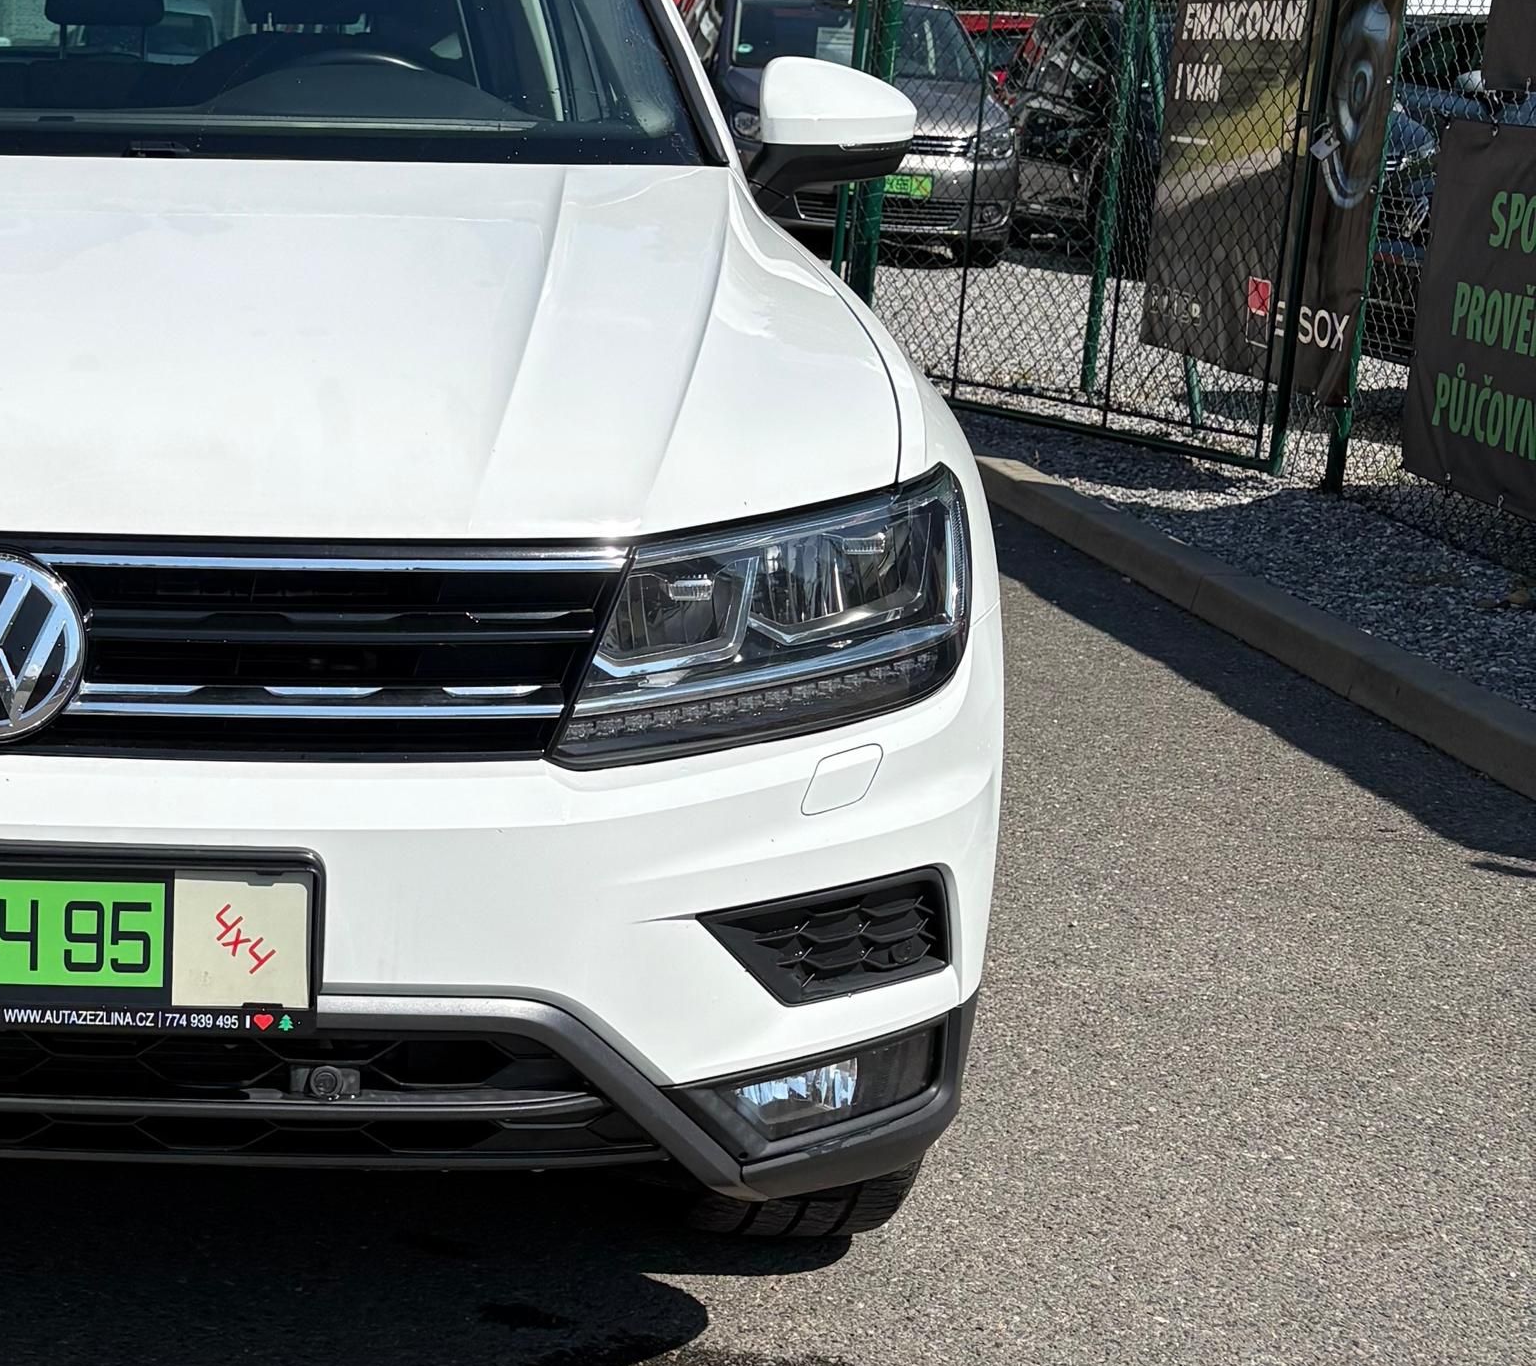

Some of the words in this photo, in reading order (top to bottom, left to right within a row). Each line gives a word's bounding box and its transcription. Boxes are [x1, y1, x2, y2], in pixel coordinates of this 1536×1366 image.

[1274, 300, 1350, 352] ESOX
[63, 900, 152, 974] 95
[3, 1008, 156, 1027] WWW.AUTAZEZLINA.CZ
[164, 1012, 188, 1028] 774
[190, 1013, 214, 1029] 939
[215, 1014, 239, 1029] 495
